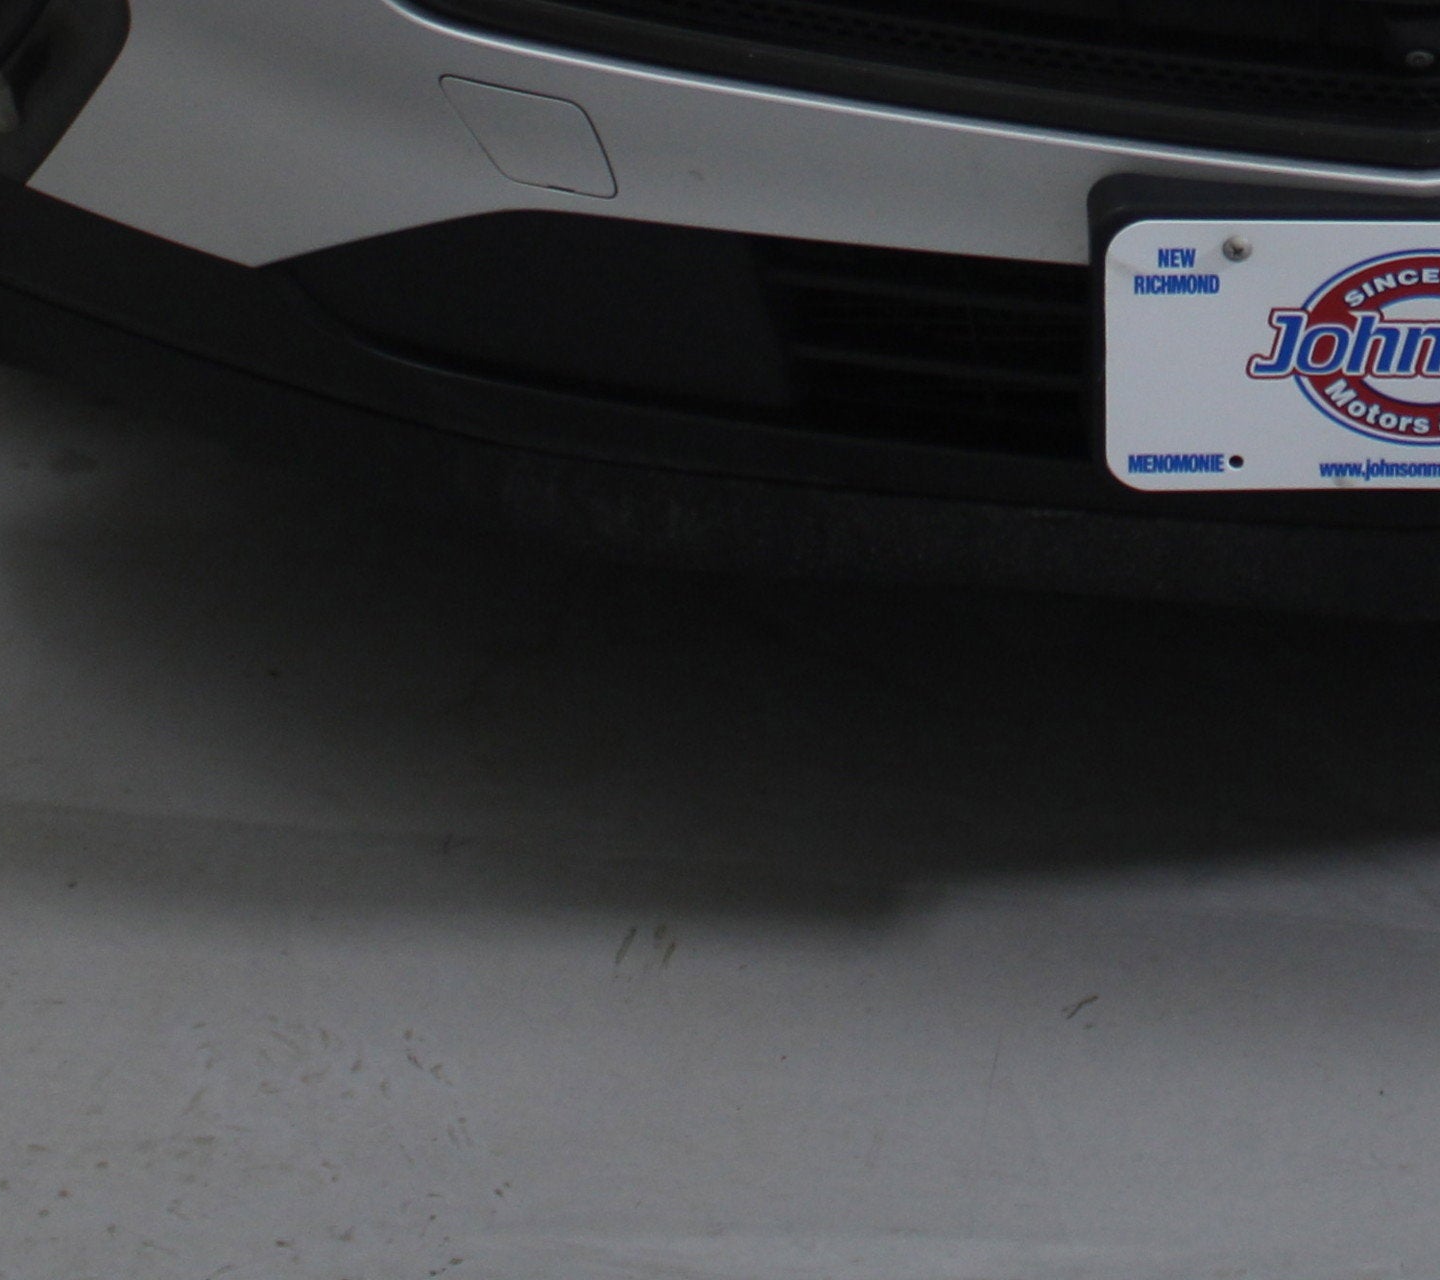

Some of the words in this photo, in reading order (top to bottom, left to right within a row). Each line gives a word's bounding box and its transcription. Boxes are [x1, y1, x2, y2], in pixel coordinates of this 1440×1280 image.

[1293, 122, 1437, 148] 923547
[1157, 247, 1197, 268] NEW
[1133, 274, 1220, 295] RICHMOND
[1344, 268, 1440, 308] SINCE
[1324, 378, 1430, 434] Motors
[1128, 453, 1225, 473] MENOMONIE
